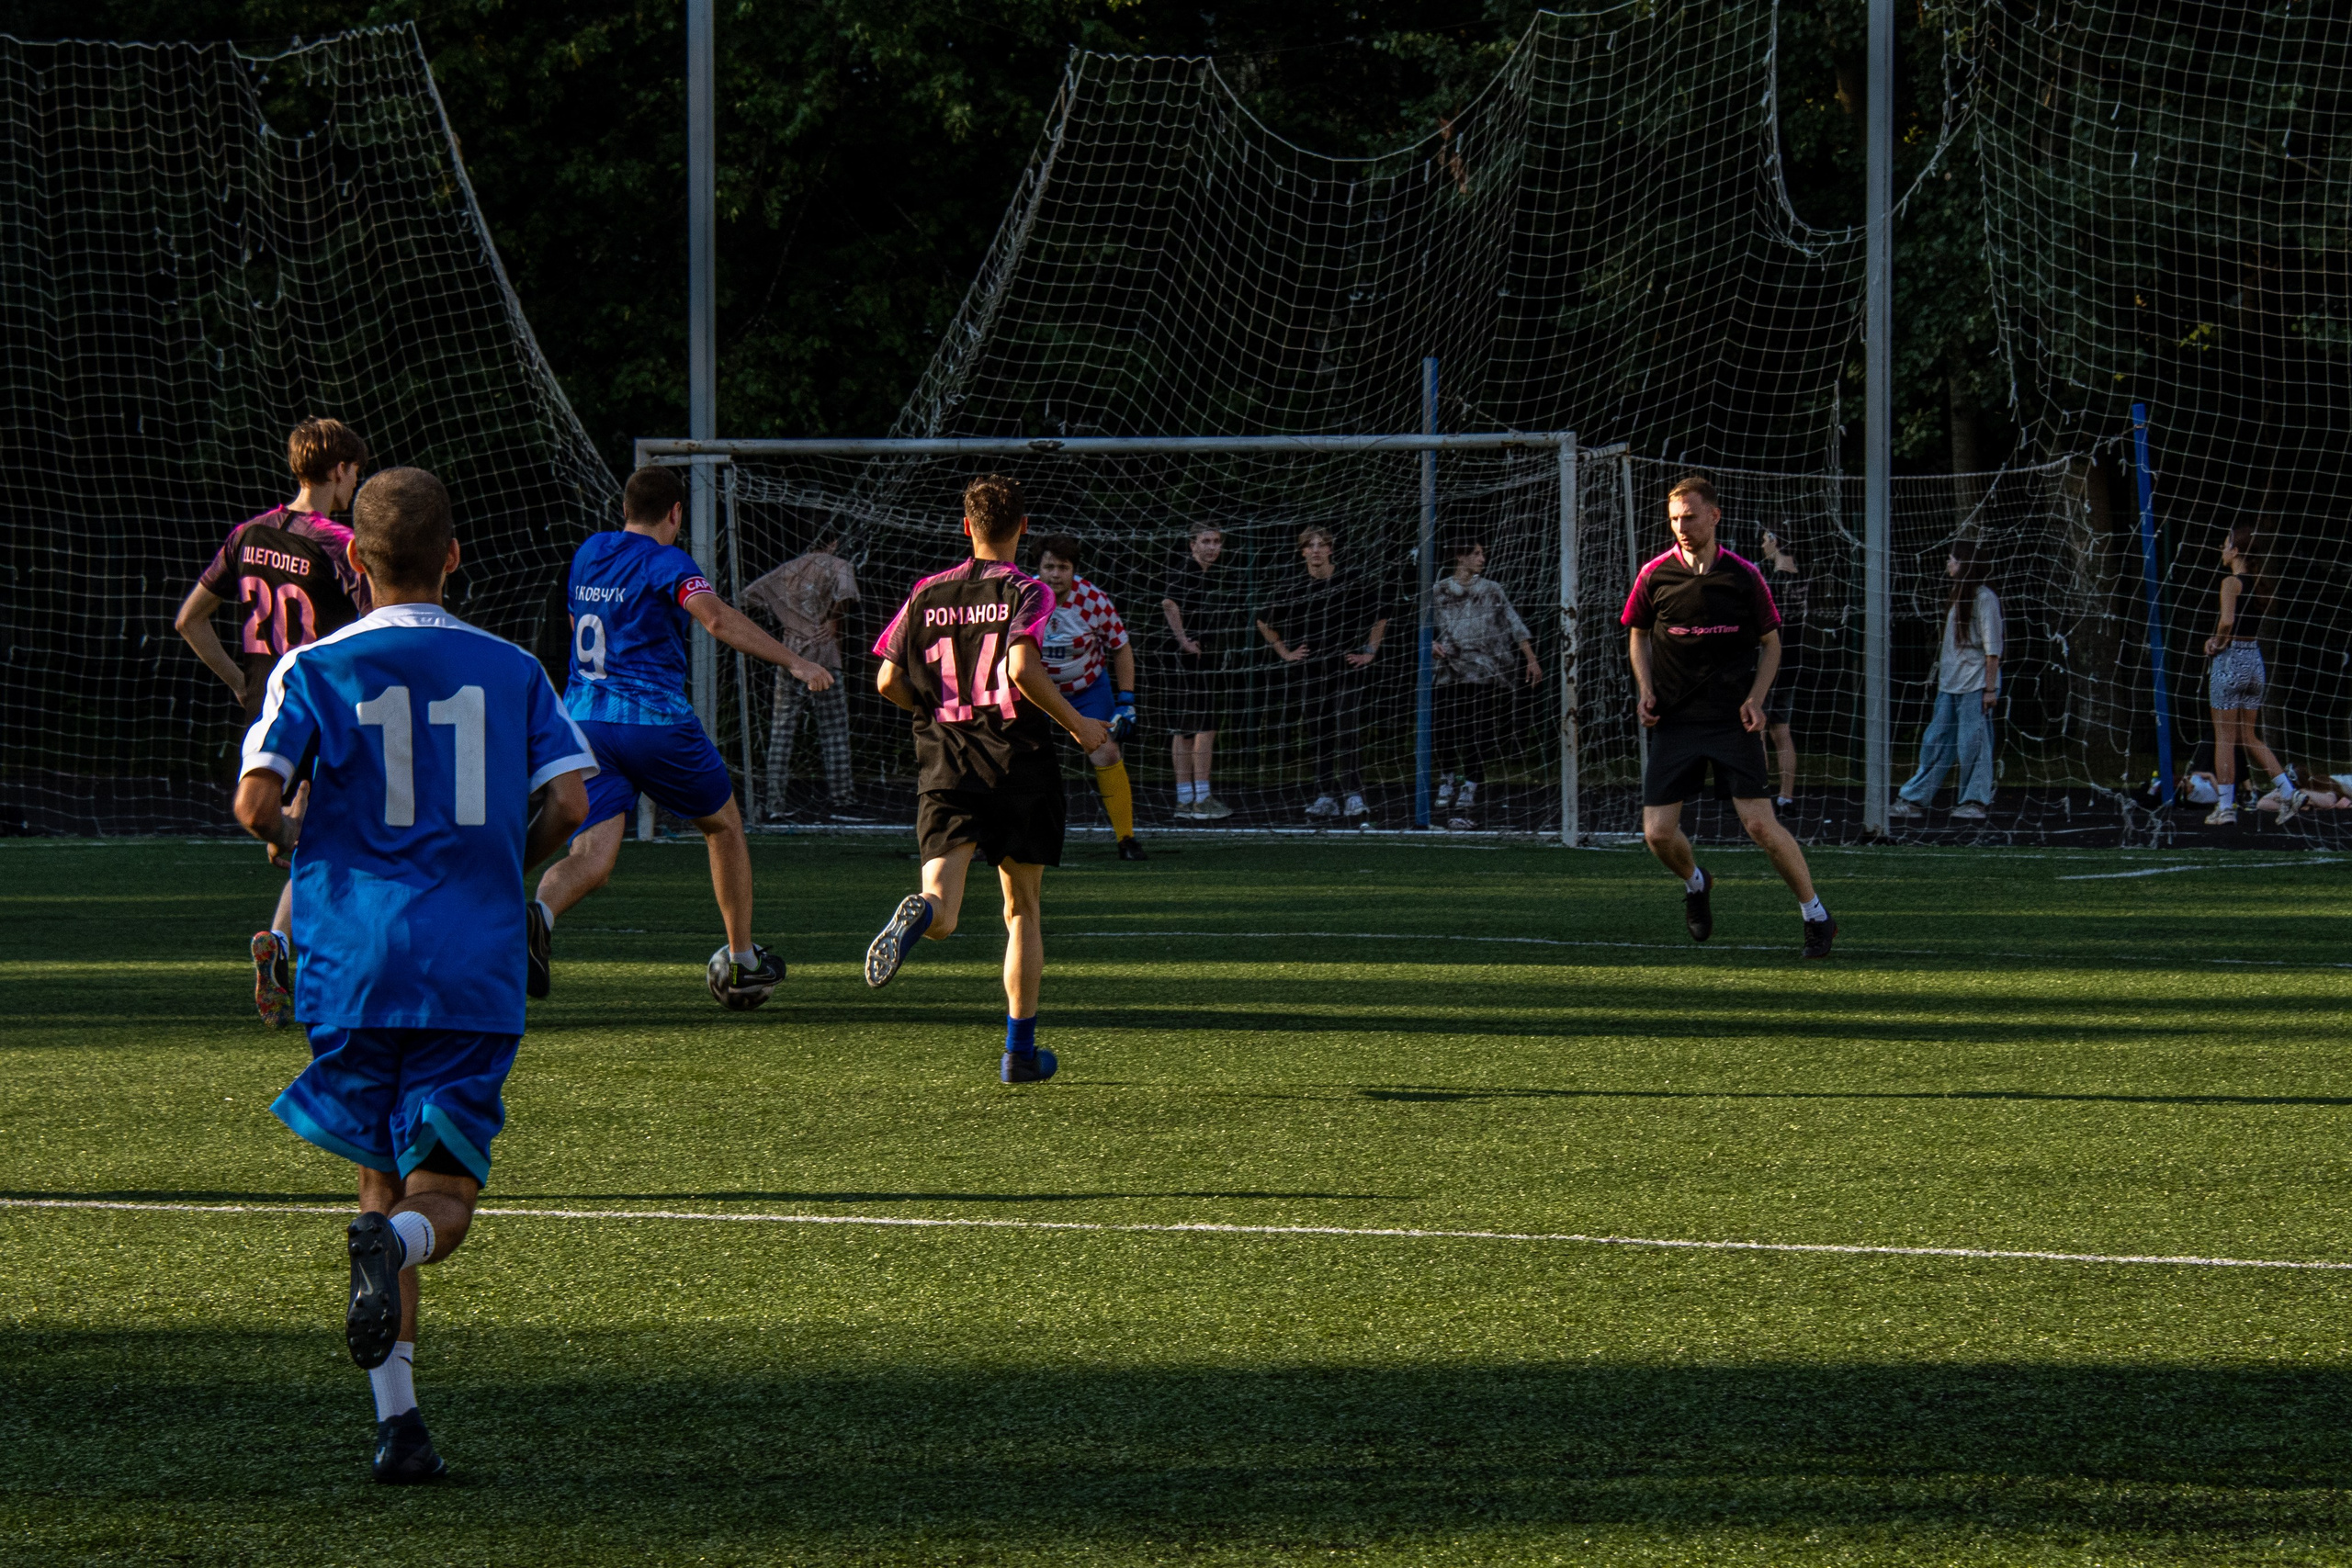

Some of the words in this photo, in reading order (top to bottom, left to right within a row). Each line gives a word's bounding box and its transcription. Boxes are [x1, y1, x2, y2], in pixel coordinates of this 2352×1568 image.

[243, 546, 311, 576] ЩЕГОЛЕВ
[238, 576, 318, 655] 20
[576, 614, 608, 682] 9
[923, 603, 1011, 627] РОМАНОВ
[924, 632, 1022, 724] 14
[1047, 646, 1066, 659] 10
[356, 684, 487, 828] 11
